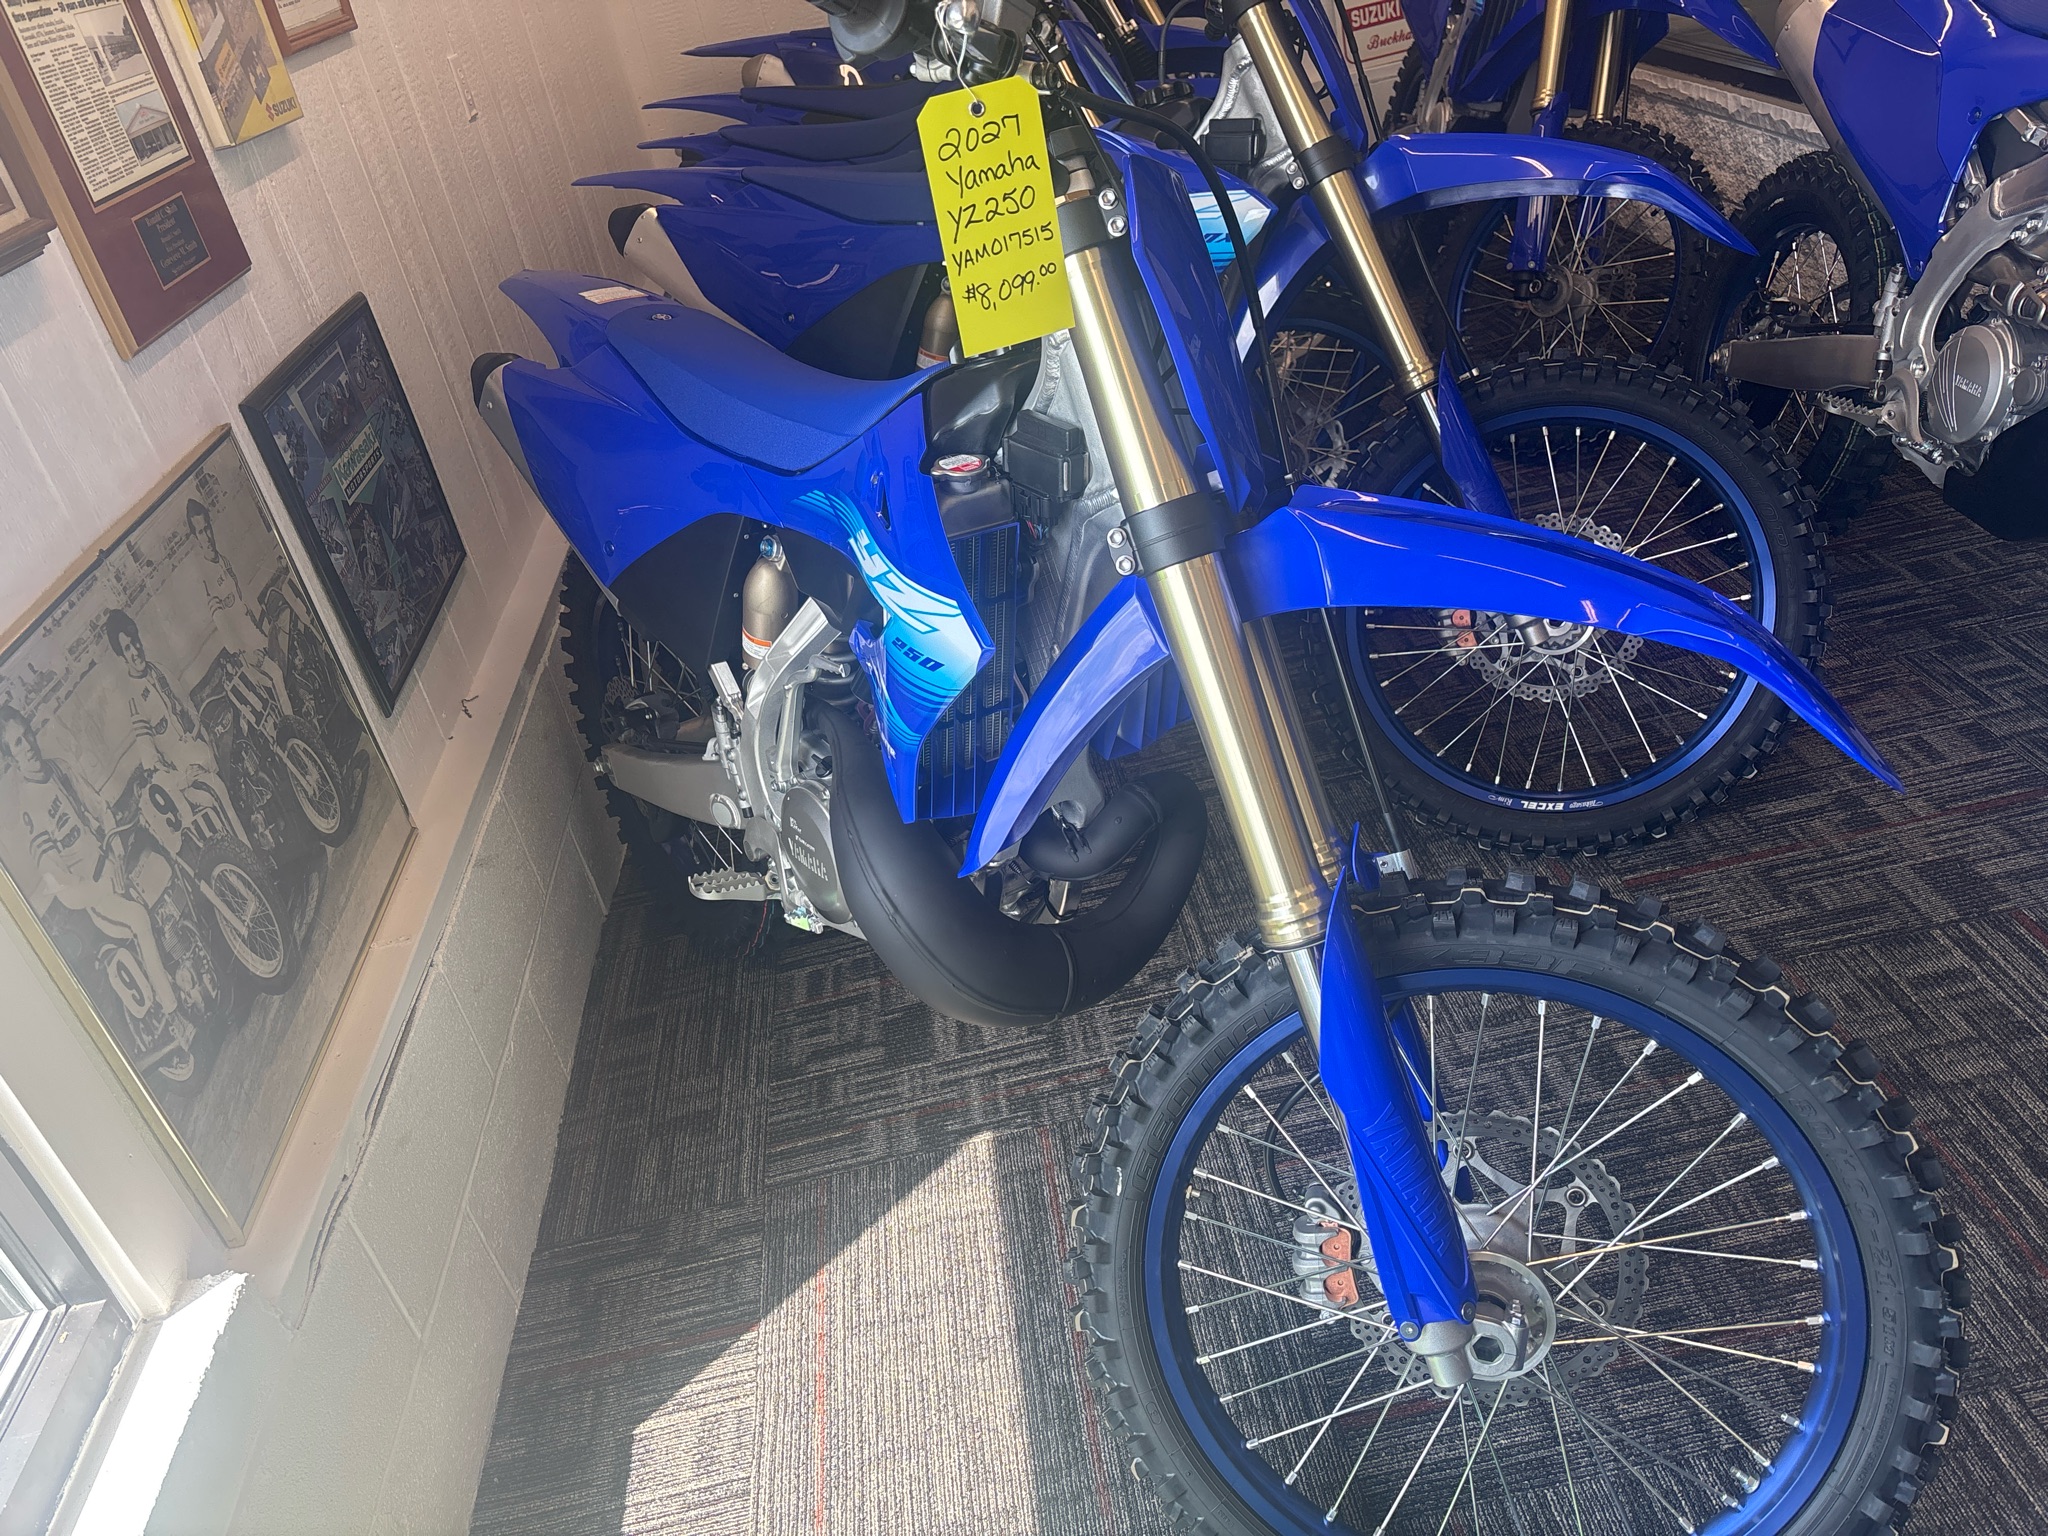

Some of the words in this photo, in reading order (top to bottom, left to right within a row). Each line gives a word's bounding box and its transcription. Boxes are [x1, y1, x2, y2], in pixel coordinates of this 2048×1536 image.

[1350, 0, 1401, 28] SUZUKI
[272, 97, 297, 117] SUZUKI
[938, 114, 1021, 161] 2027
[946, 150, 1041, 199] Yamaha
[947, 185, 1036, 244] YZ250
[952, 221, 1054, 277] YAM017515
[1954, 374, 1983, 398] YAMAHA
[333, 422, 377, 486] Kawasaki
[345, 448, 382, 497] MOTORSPORTS
[891, 637, 945, 672] 250
[22, 811, 35, 835] 9
[149, 783, 183, 832] 9
[1520, 800, 1565, 811] EXCEL
[787, 837, 829, 882] YAMAHA
[116, 960, 146, 1008] 9
[1362, 1101, 1453, 1257] YAMAHA
